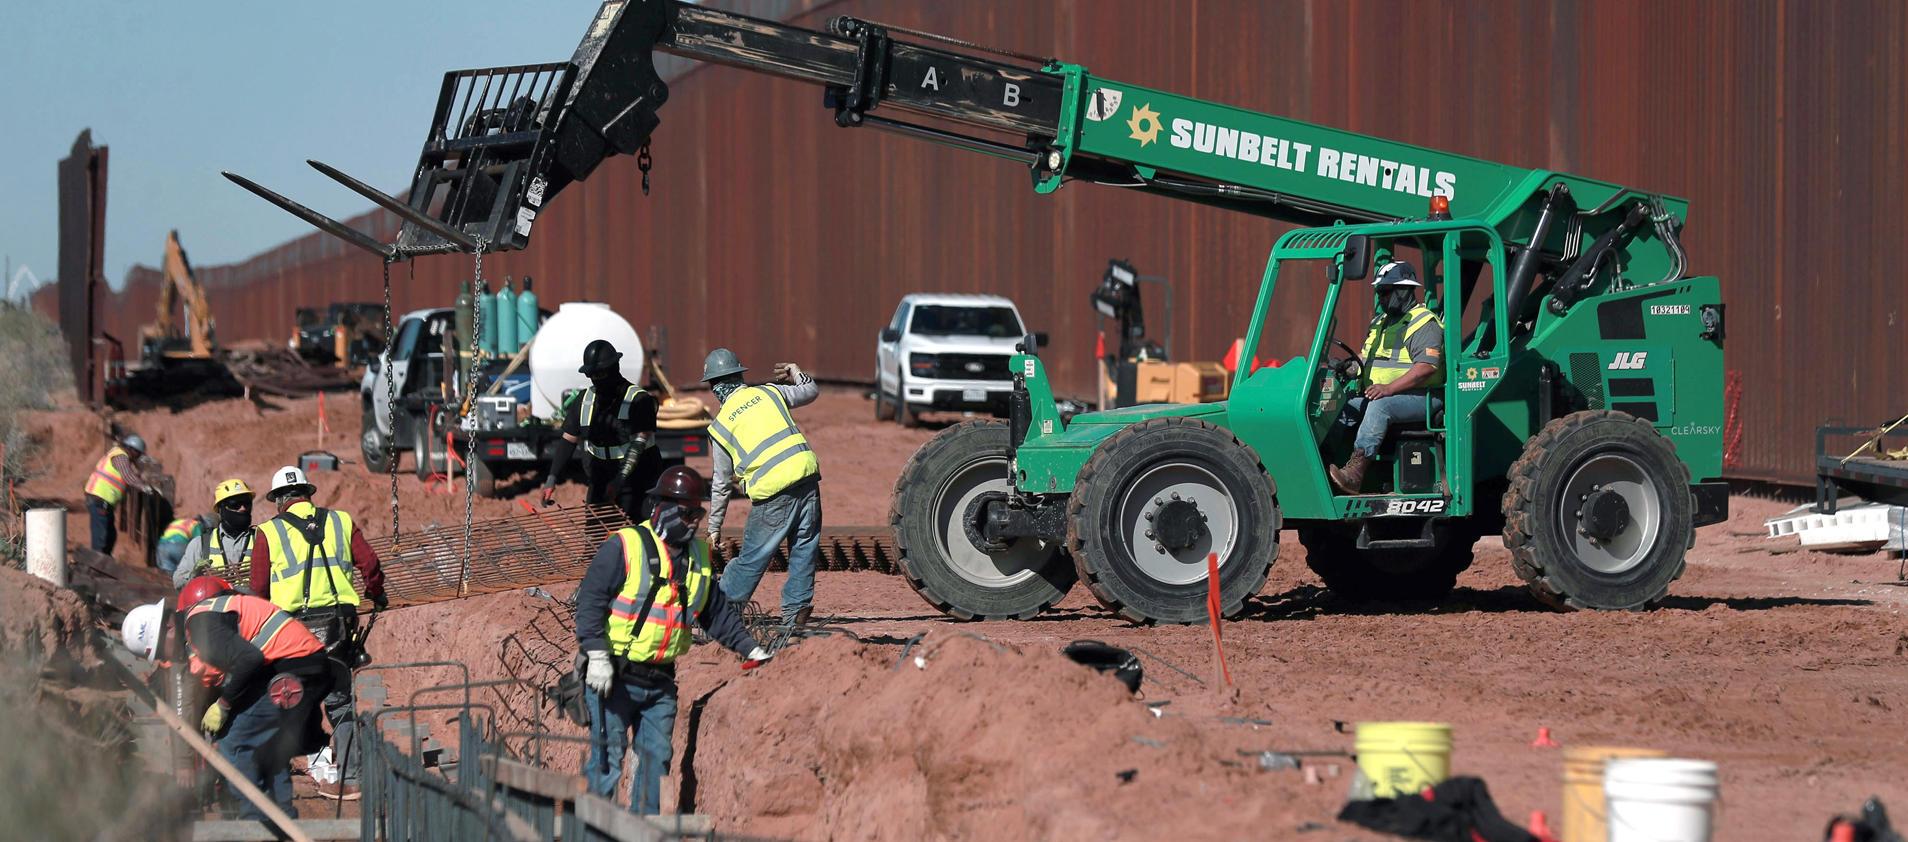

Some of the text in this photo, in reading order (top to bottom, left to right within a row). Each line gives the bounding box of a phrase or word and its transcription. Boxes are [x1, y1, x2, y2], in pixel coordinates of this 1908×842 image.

[921, 66, 939, 91] A
[1003, 83, 1021, 107] B
[1170, 118, 1456, 202] SUNBELT RENTALS
[1608, 352, 1647, 370] JLG
[1458, 381, 1486, 390] SUNBELT
[728, 395, 763, 422] SPENCER
[1671, 422, 1721, 435] CLEARSKY
[1386, 500, 1445, 514] 8042
